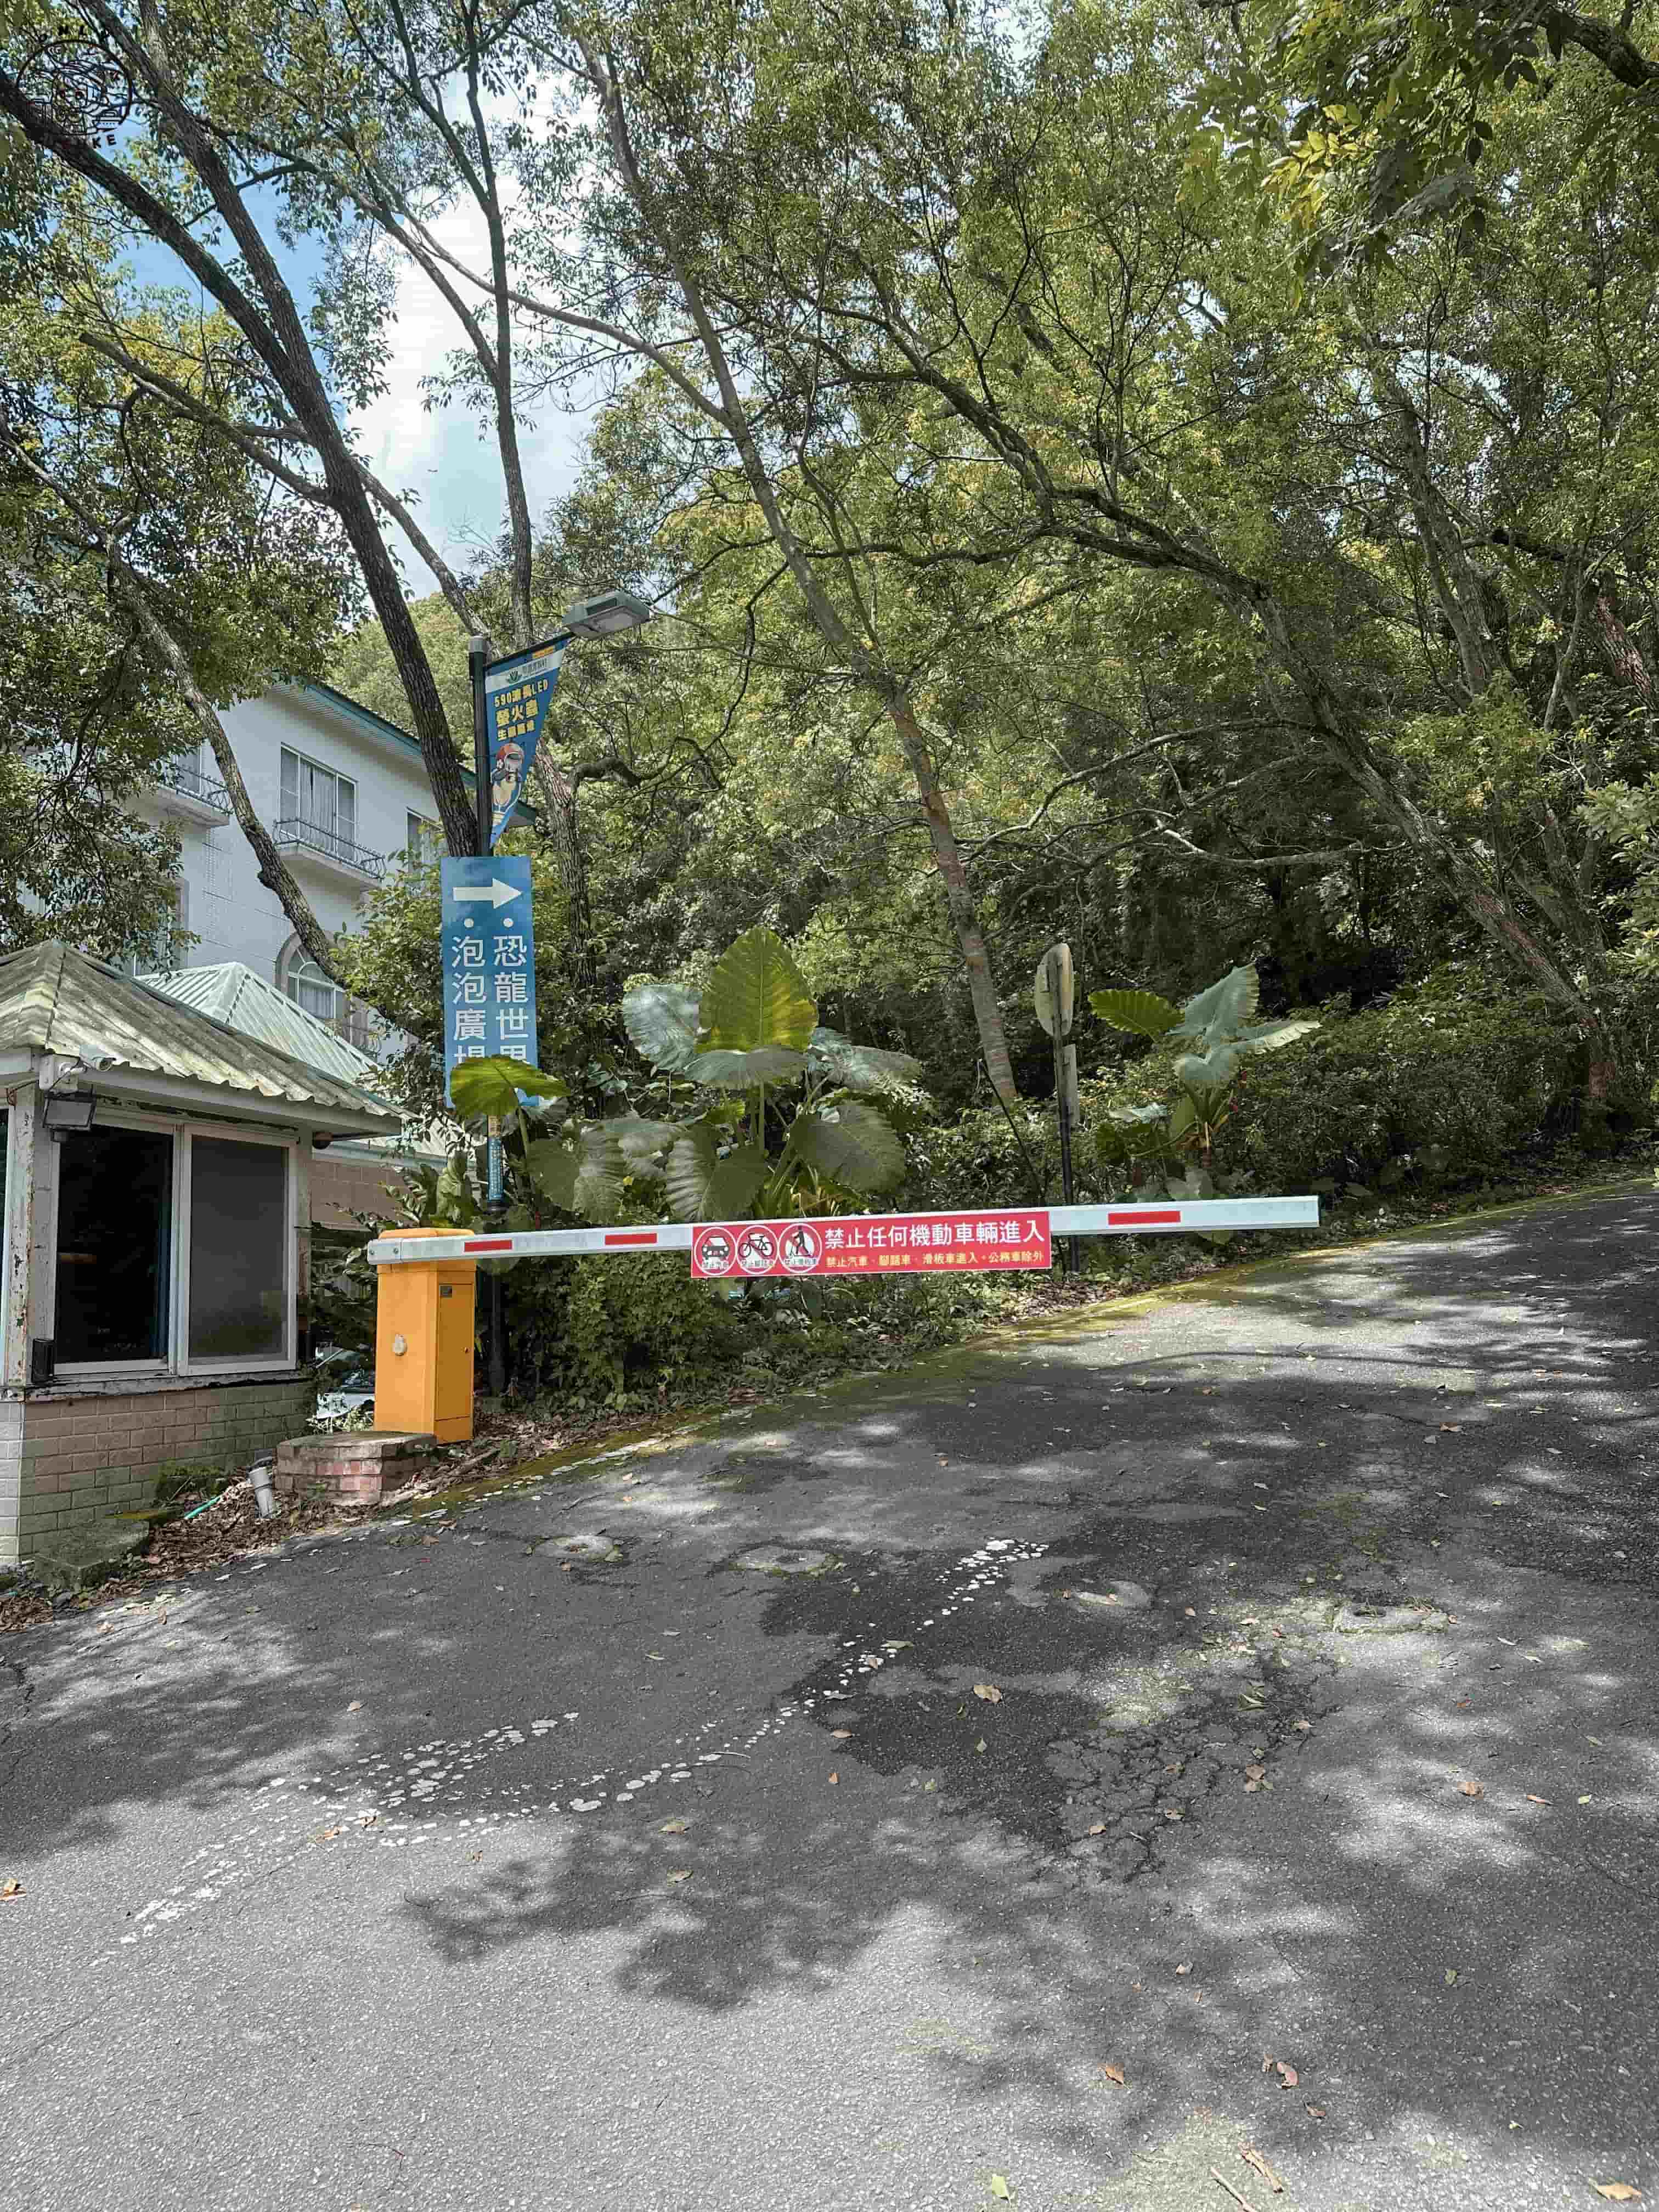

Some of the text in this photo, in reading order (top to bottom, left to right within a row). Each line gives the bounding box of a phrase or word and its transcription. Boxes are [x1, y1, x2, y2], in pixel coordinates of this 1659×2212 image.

[825, 1220, 1045, 1249] 禁止任何機動車輛進入
